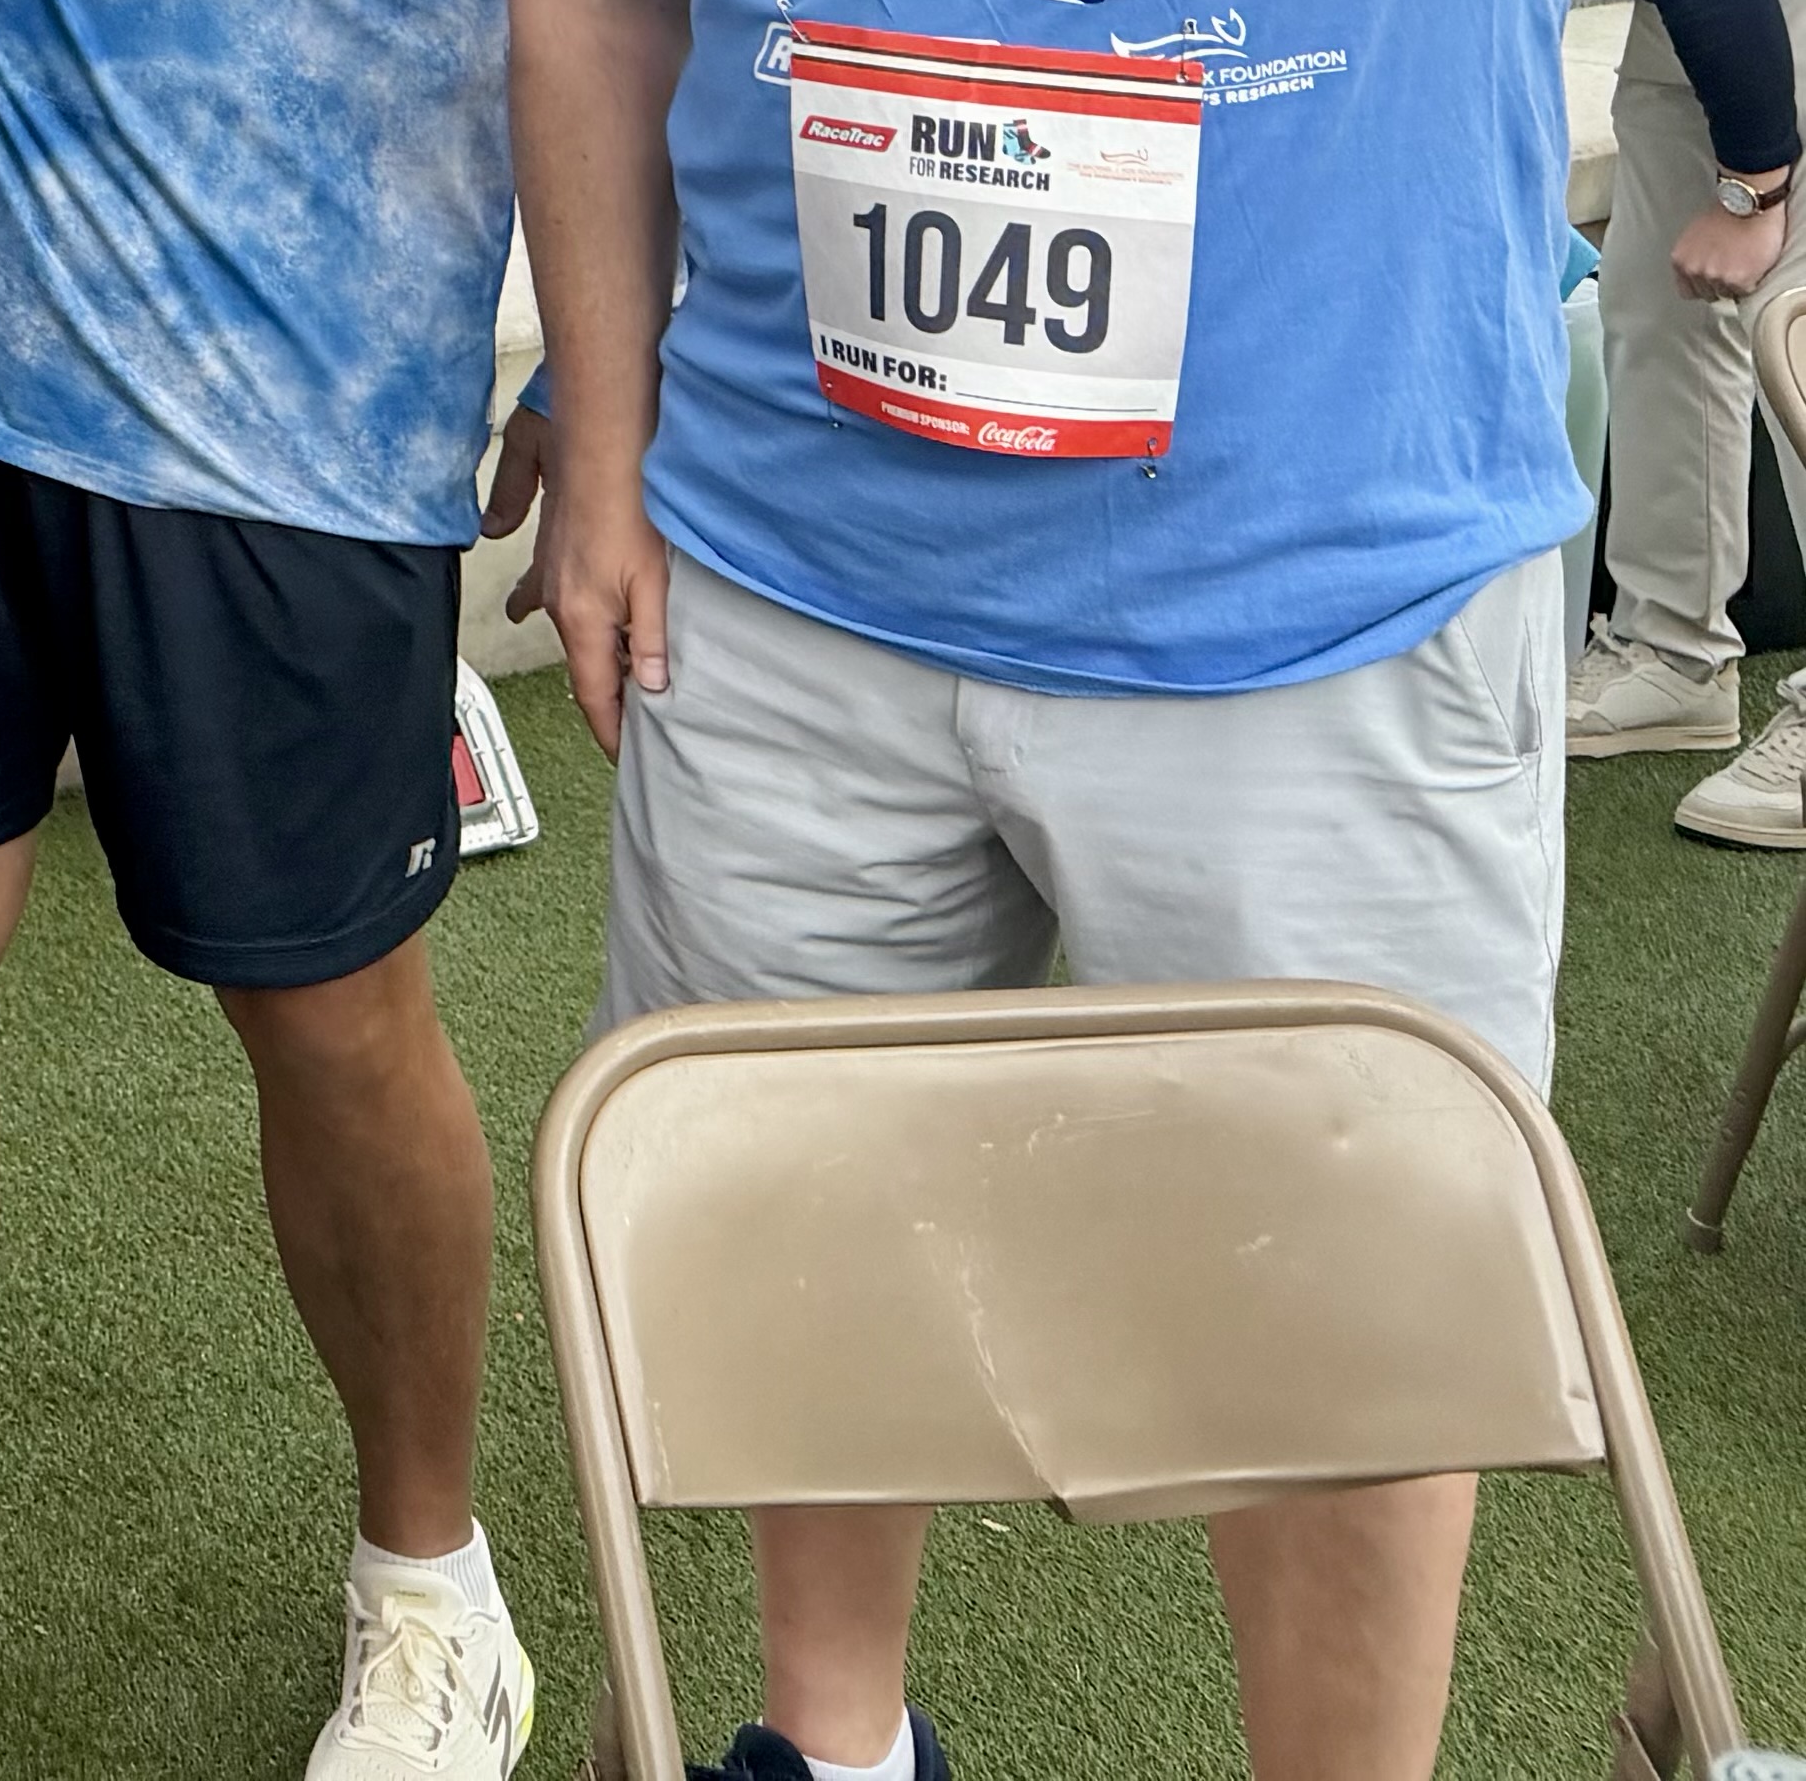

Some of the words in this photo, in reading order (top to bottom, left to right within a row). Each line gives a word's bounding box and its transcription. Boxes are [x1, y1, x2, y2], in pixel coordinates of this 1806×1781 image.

[1220, 49, 1347, 86] FOUNDATION
[1226, 76, 1314, 104] RESEARCH
[808, 120, 885, 148] RaceTrac
[911, 114, 996, 162] RUN
[909, 156, 935, 177] FOR
[939, 162, 1051, 191] RESEARCH
[853, 203, 1112, 354] 1049
[820, 335, 828, 355] I
[832, 339, 878, 373] RUN
[883, 355, 947, 391] FOR:
